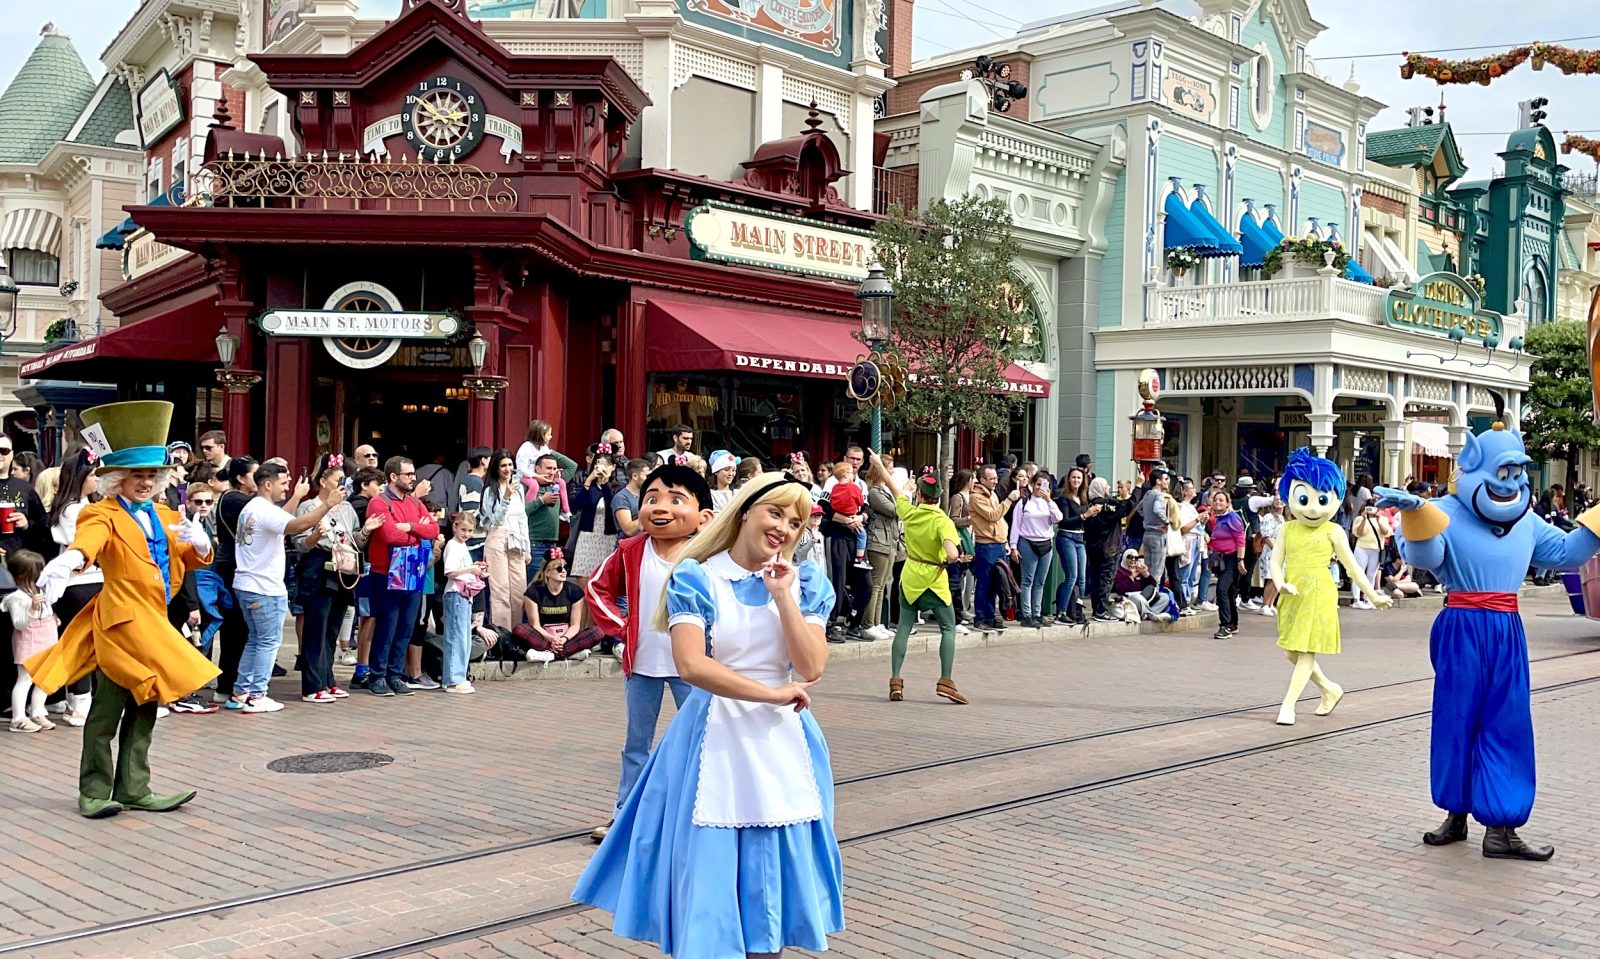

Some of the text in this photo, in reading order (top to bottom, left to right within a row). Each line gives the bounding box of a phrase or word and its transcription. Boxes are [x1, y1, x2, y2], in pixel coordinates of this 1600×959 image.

[436, 77, 447, 86] 12
[406, 95, 416, 104] 10
[468, 96, 474, 104] 2
[472, 114, 479, 122] 3
[366, 119, 399, 140] TIME TO
[488, 120, 521, 142] TRADE IN
[437, 150, 444, 158] 6
[455, 145, 461, 154] 5
[731, 221, 786, 252] MAIN
[793, 232, 865, 267] STREET
[286, 316, 434, 332] MAIN ST. MOTORS
